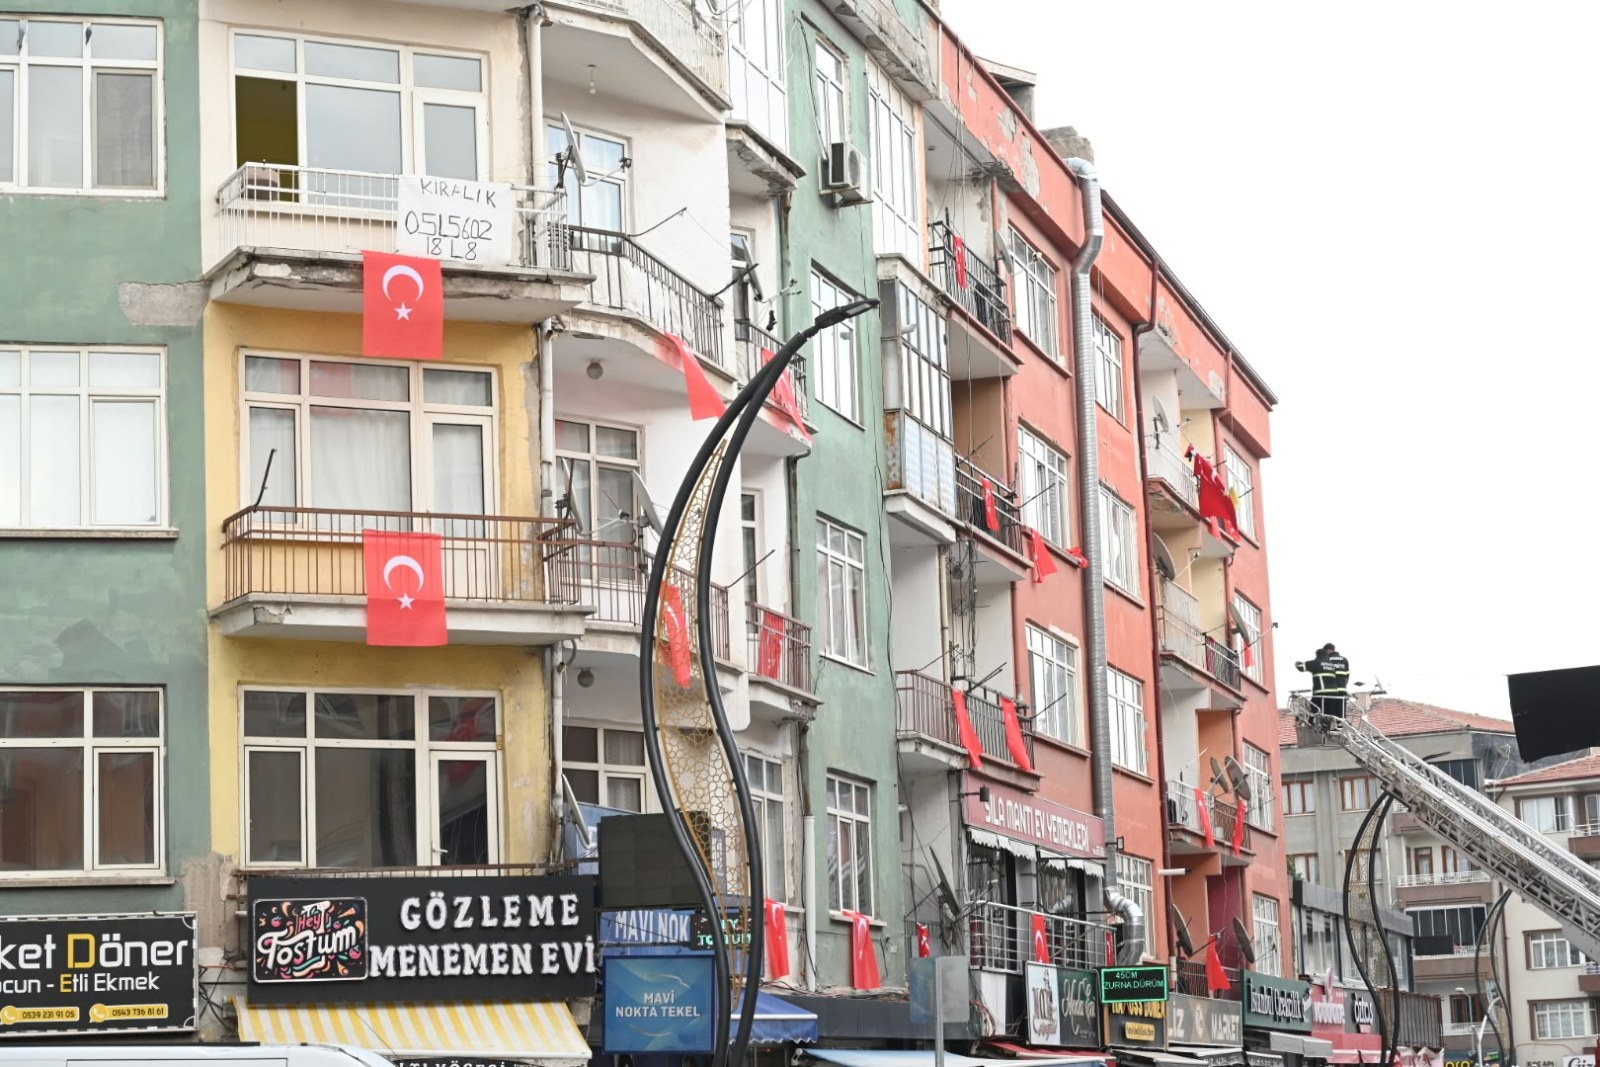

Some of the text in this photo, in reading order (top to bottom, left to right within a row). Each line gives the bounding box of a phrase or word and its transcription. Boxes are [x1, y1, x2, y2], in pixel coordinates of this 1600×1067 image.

[426, 236, 442, 256] 18
[400, 890, 580, 931] GÖZLEME
[67, 933, 188, 969] Döner
[370, 934, 597, 977] MENEMEN EVİ
[60, 973, 89, 993] Etli
[94, 971, 160, 992] Ekmek
[1103, 981, 1133, 990] ZURNA
[643, 990, 676, 1004] MAVİ
[132, 1008, 146, 1016] 736
[615, 1005, 700, 1018] NOKTA TEKEL
